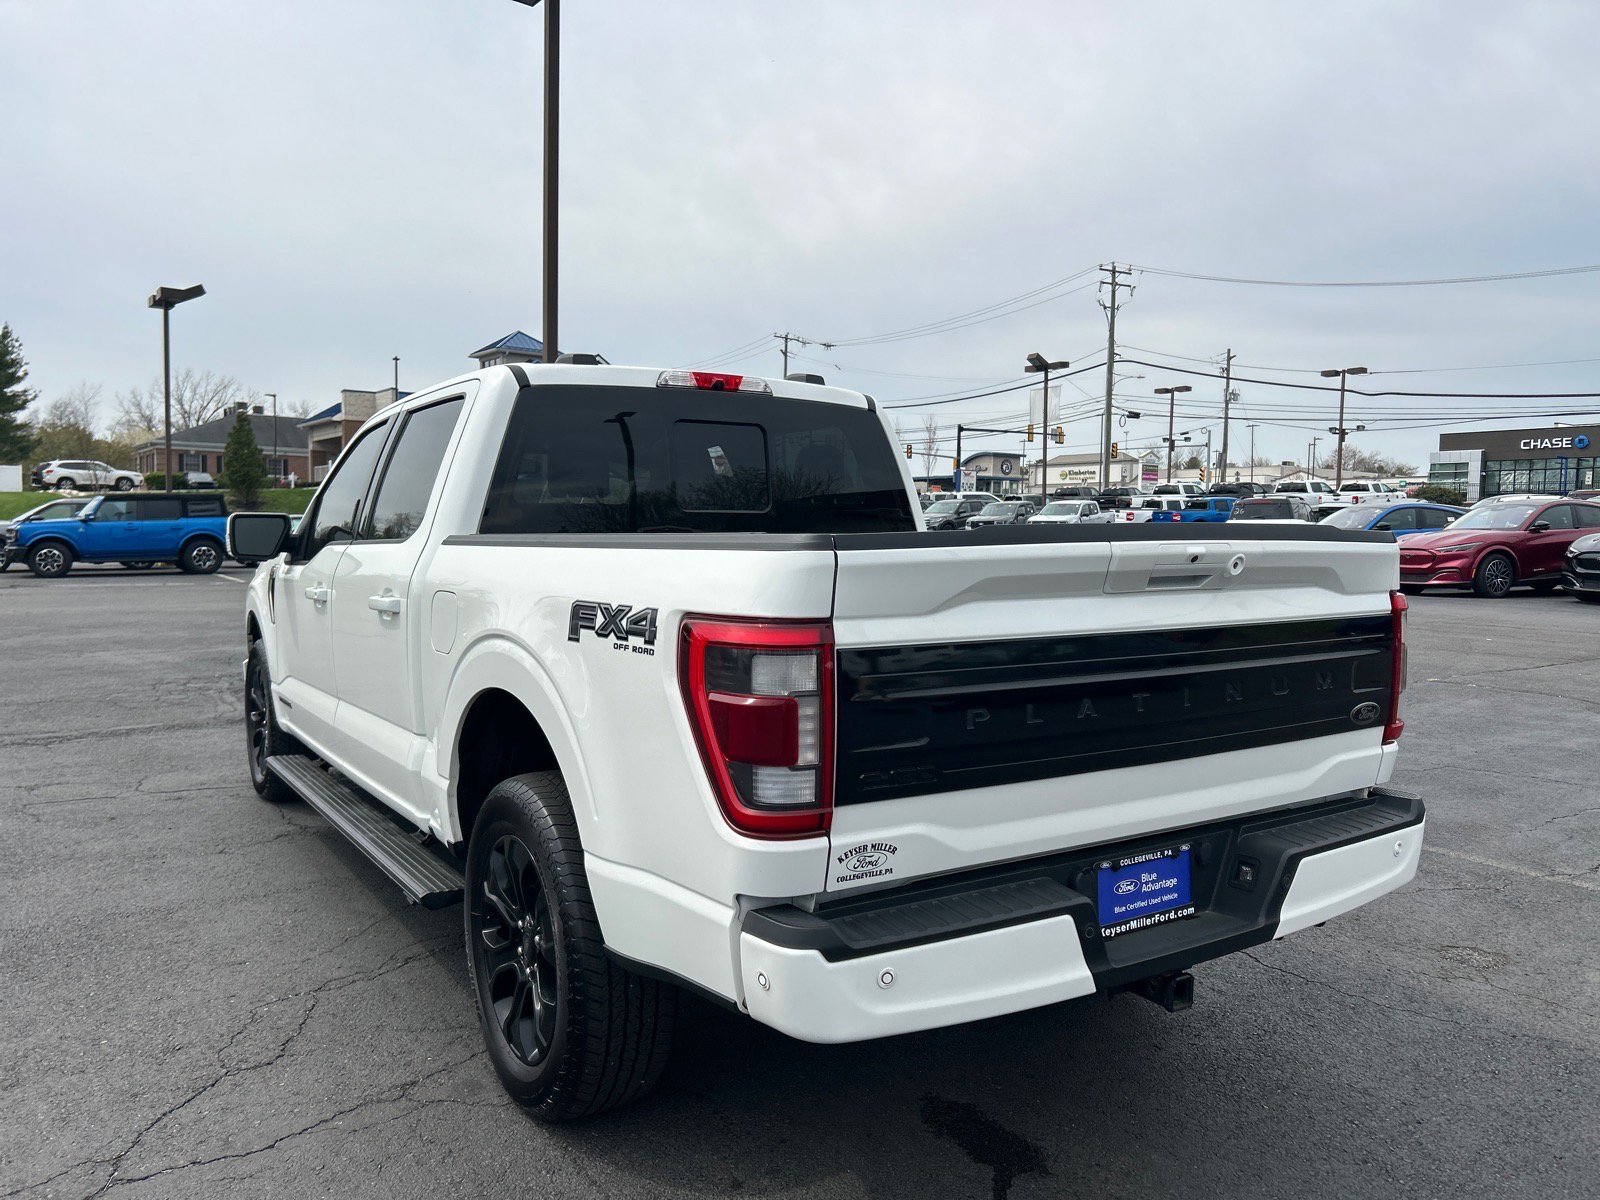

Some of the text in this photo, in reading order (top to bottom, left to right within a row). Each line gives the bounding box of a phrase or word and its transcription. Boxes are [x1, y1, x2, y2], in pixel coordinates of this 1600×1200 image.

[1520, 437, 1572, 450] CHASE
[567, 599, 659, 646] FX4
[613, 642, 655, 656] OFF ROAD
[966, 672, 1335, 730] PLATINUM
[837, 842, 898, 865] KEYSER MILLER
[1119, 851, 1163, 867] COLLEGEVILLE,
[1164, 849, 1172, 857] PA
[853, 854, 881, 870] Ford
[1141, 872, 1157, 883] Blue
[1141, 877, 1178, 893] Advantage
[1118, 881, 1135, 893] Ford
[1114, 892, 1178, 914] Blue Certified Used Vehicle
